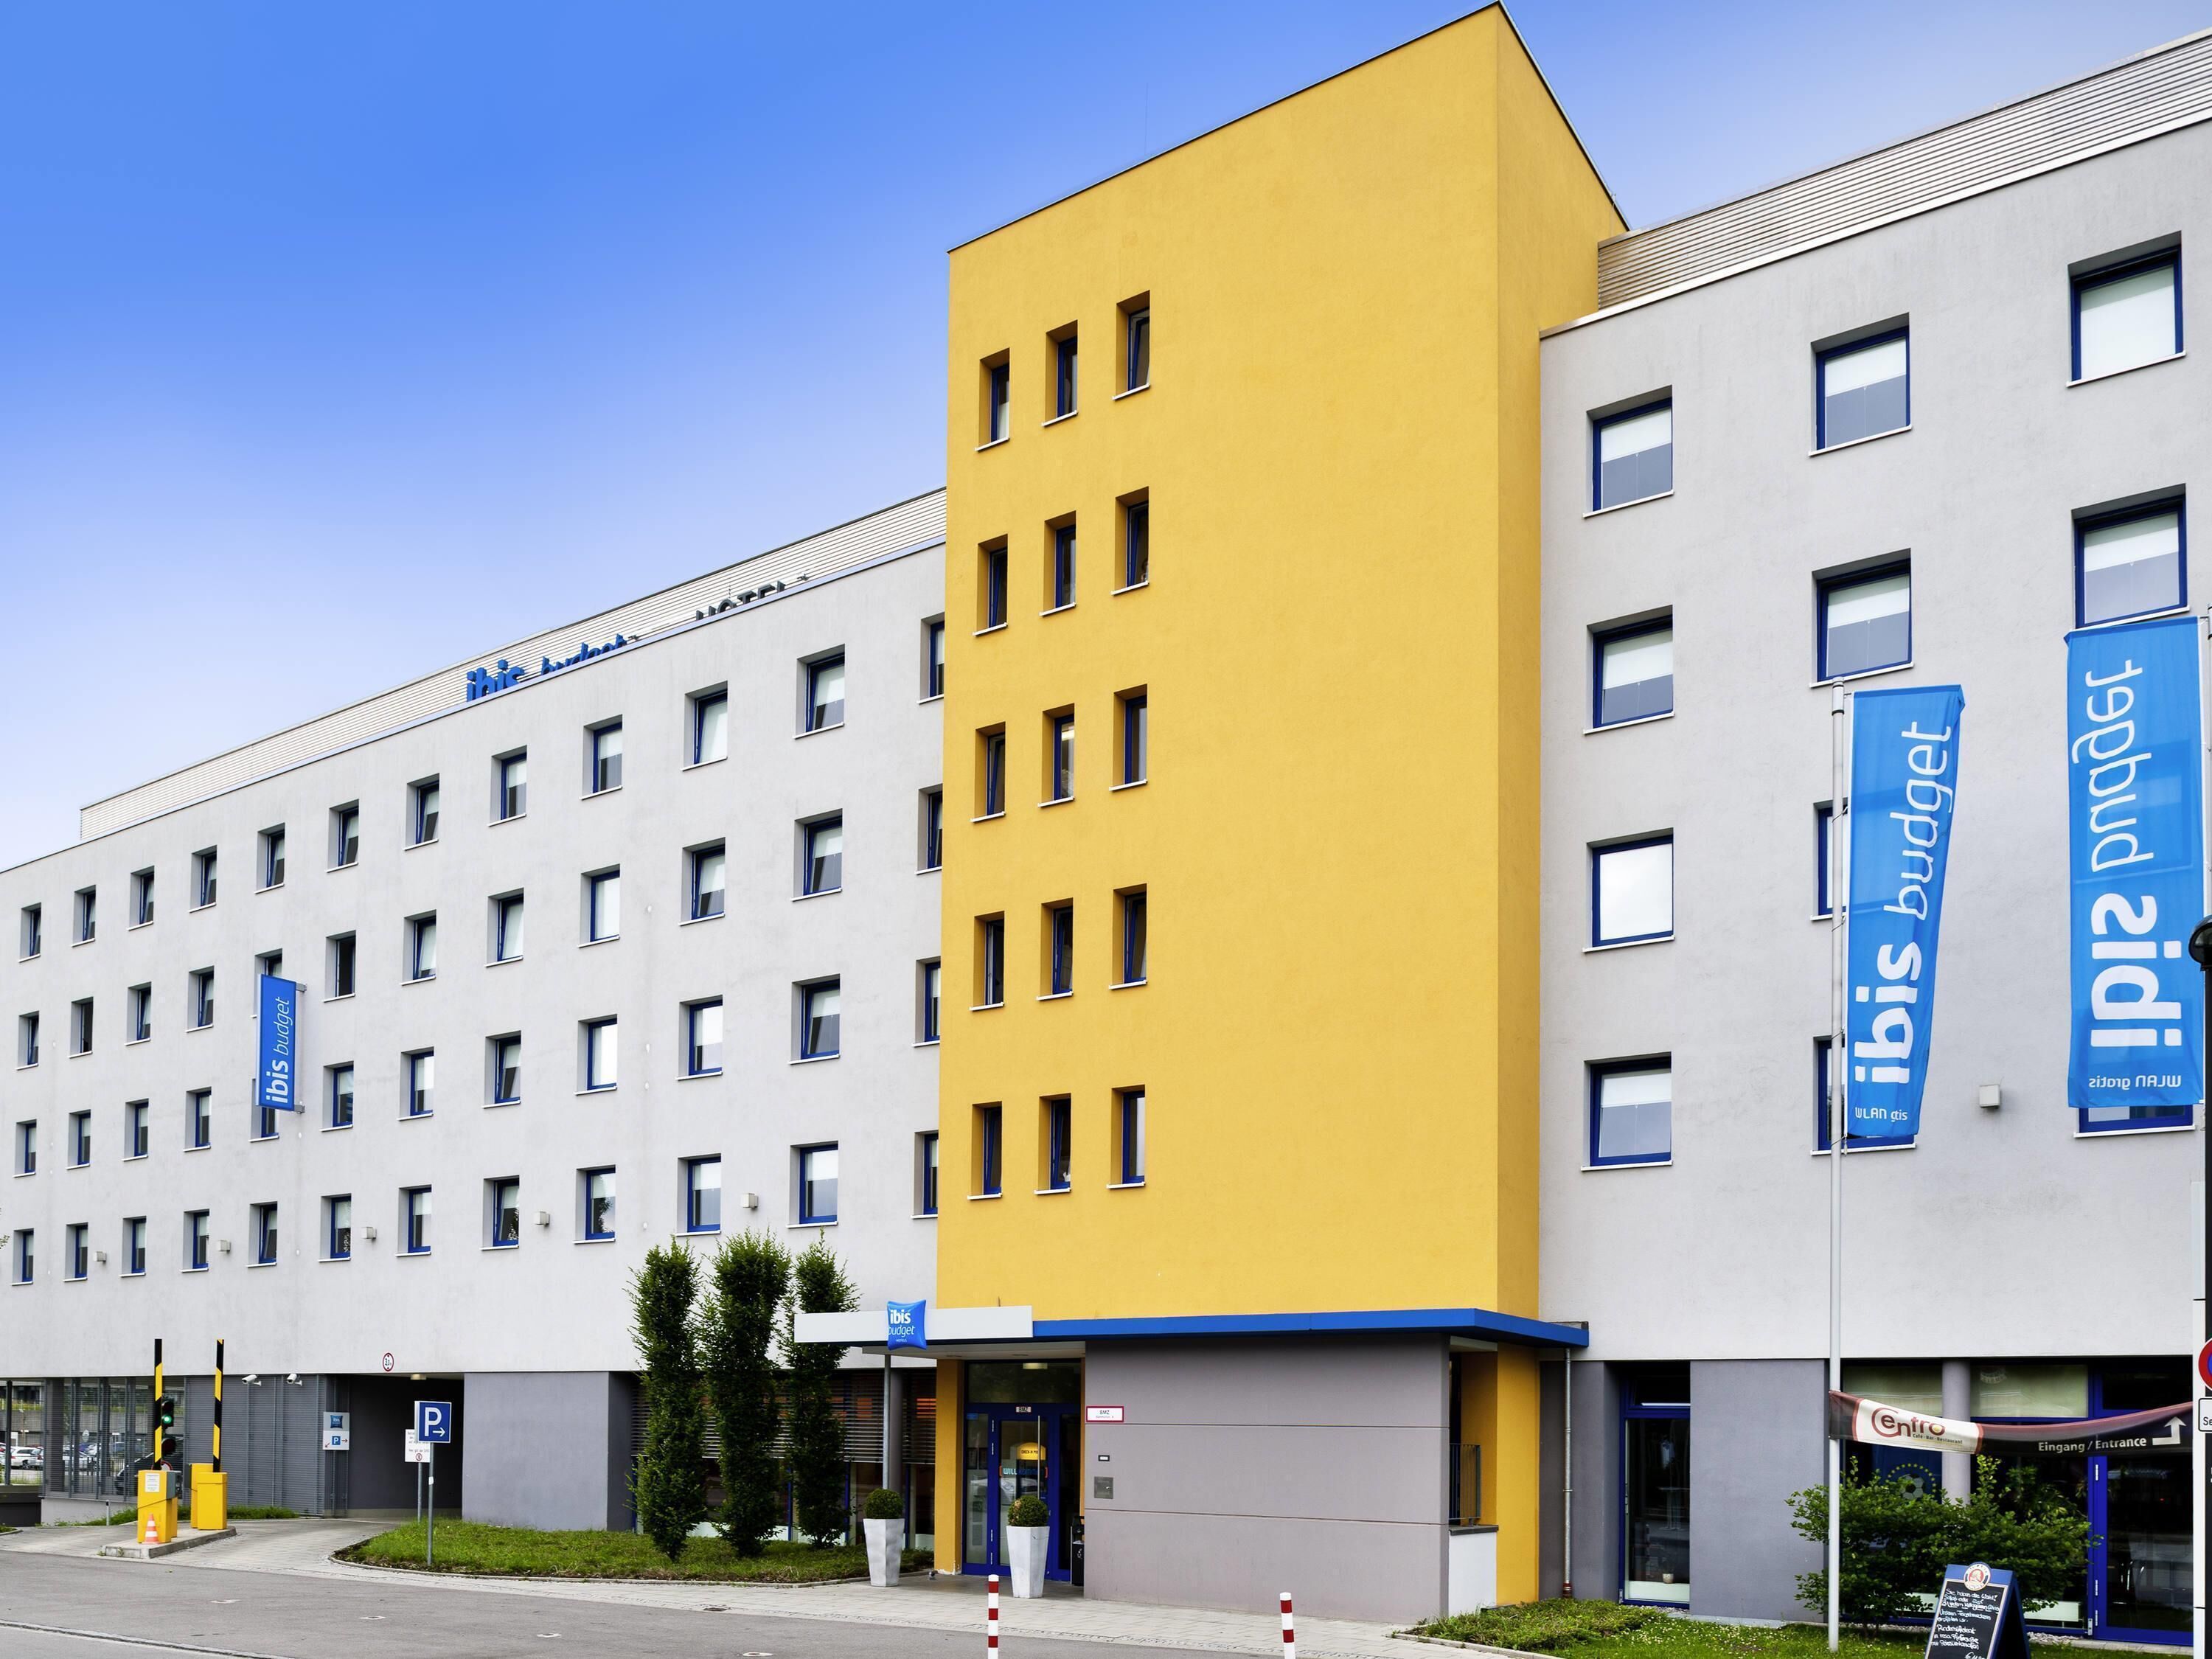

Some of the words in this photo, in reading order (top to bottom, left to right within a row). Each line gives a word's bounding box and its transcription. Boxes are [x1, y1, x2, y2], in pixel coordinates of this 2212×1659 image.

[467, 659, 524, 702] ibis
[1883, 721, 1953, 921] budget
[273, 996, 293, 1056] budget
[1854, 942, 1922, 1084] ibis
[266, 1060, 288, 1103] ibis
[1855, 1107, 1887, 1119] WLAN
[888, 1324, 915, 1338] budget
[890, 1309, 911, 1324] ibis
[425, 1407, 442, 1436] P
[1871, 1407, 1946, 1438] Centro
[333, 1436, 338, 1444] P
[2038, 1441, 2085, 1453] Eingang
[2095, 1437, 2147, 1450] Entrance
